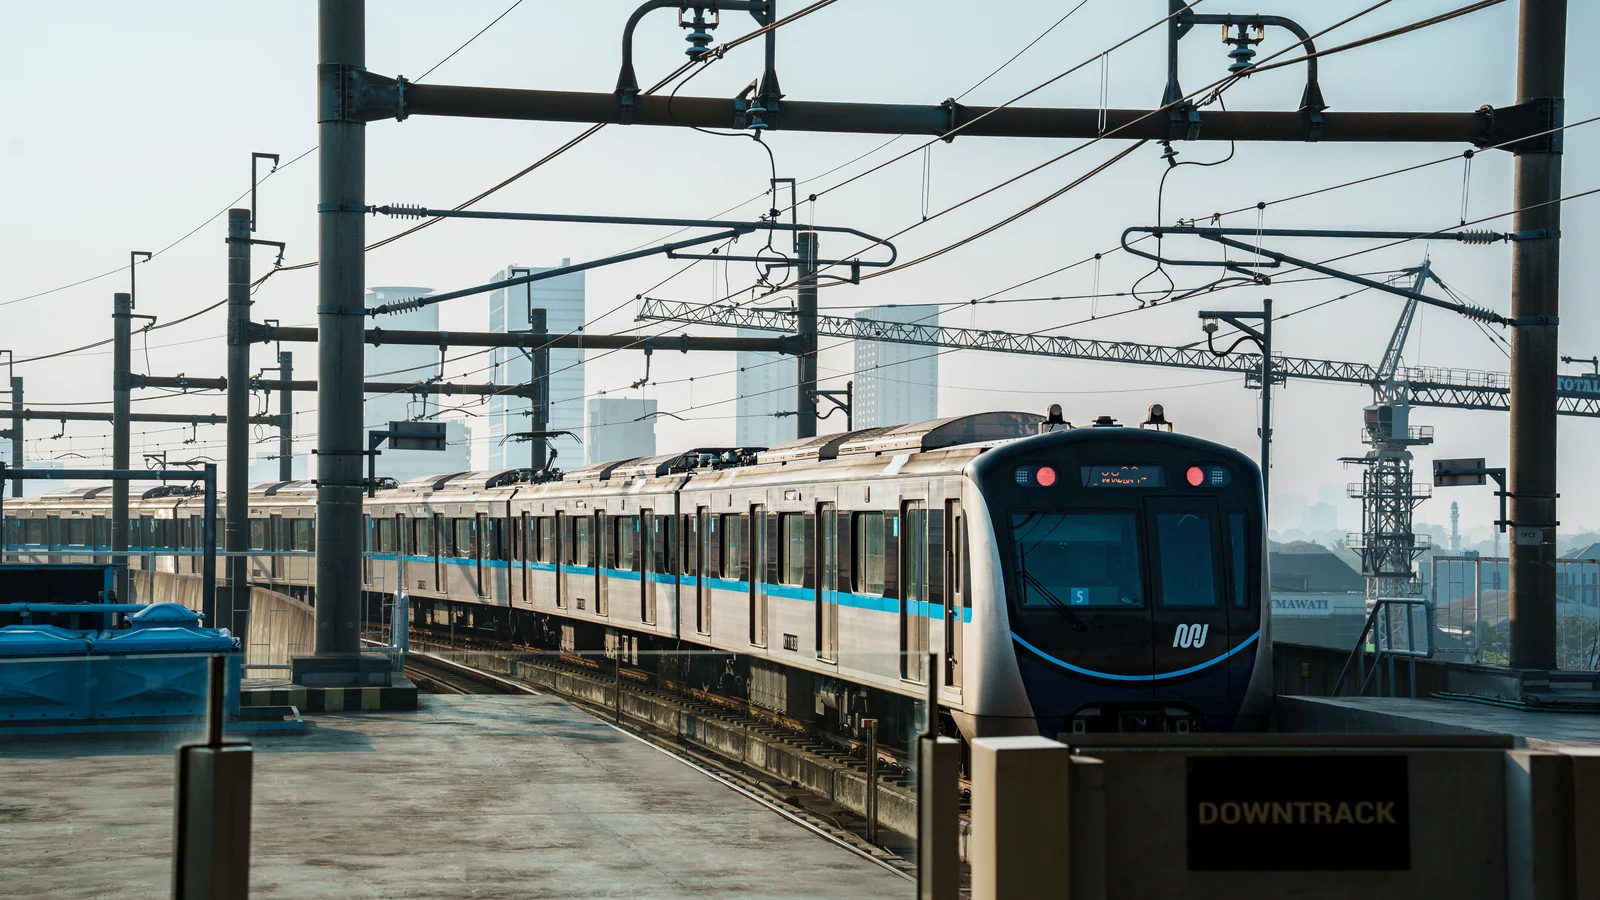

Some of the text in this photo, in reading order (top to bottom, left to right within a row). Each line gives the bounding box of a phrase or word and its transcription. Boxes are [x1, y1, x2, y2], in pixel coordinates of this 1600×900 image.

[1557, 377, 1600, 393] TOTAL
[1076, 590, 1084, 603] 5
[1199, 801, 1397, 825] DOWNTRACK
